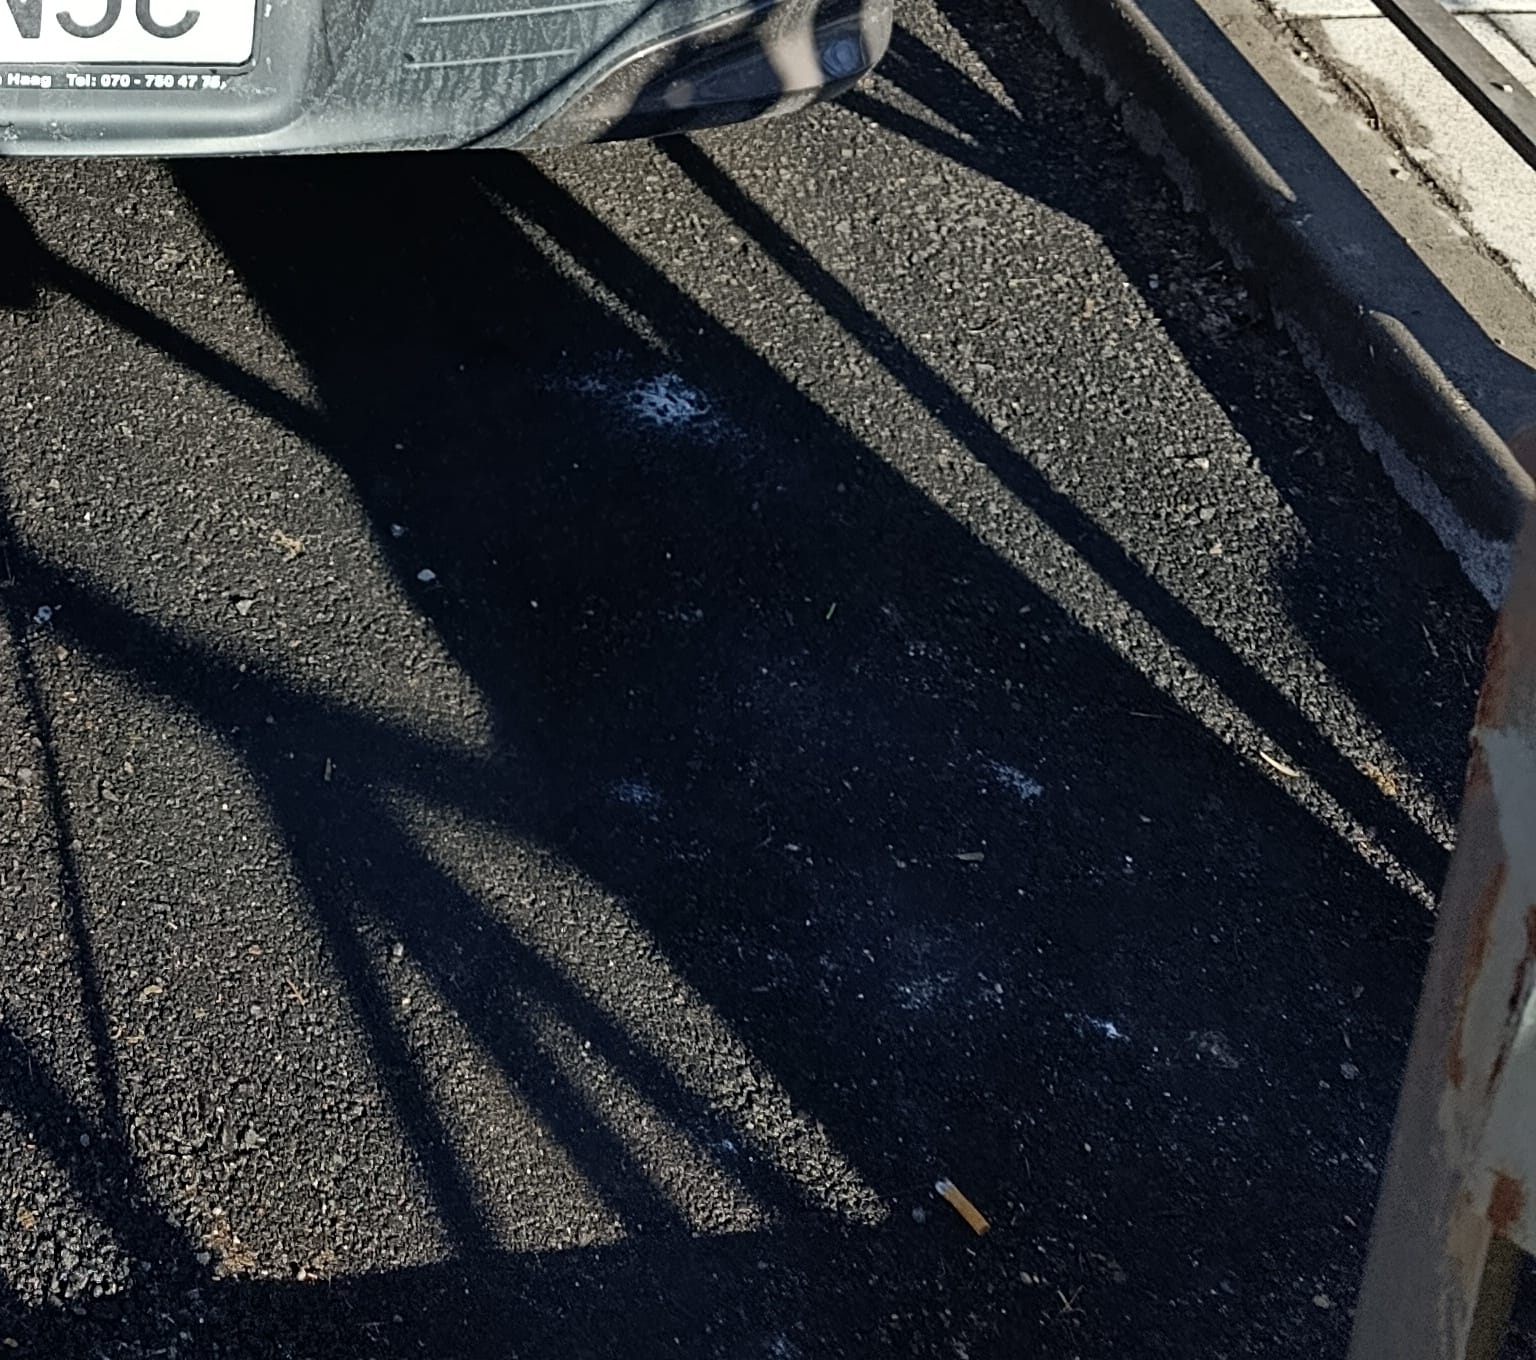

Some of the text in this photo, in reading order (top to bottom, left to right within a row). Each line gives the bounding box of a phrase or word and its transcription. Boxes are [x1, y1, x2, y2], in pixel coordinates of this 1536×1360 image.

[7, 72, 52, 89] Haag
[66, 73, 97, 87] Tel:
[100, 74, 131, 88] 070
[177, 75, 199, 89] 47
